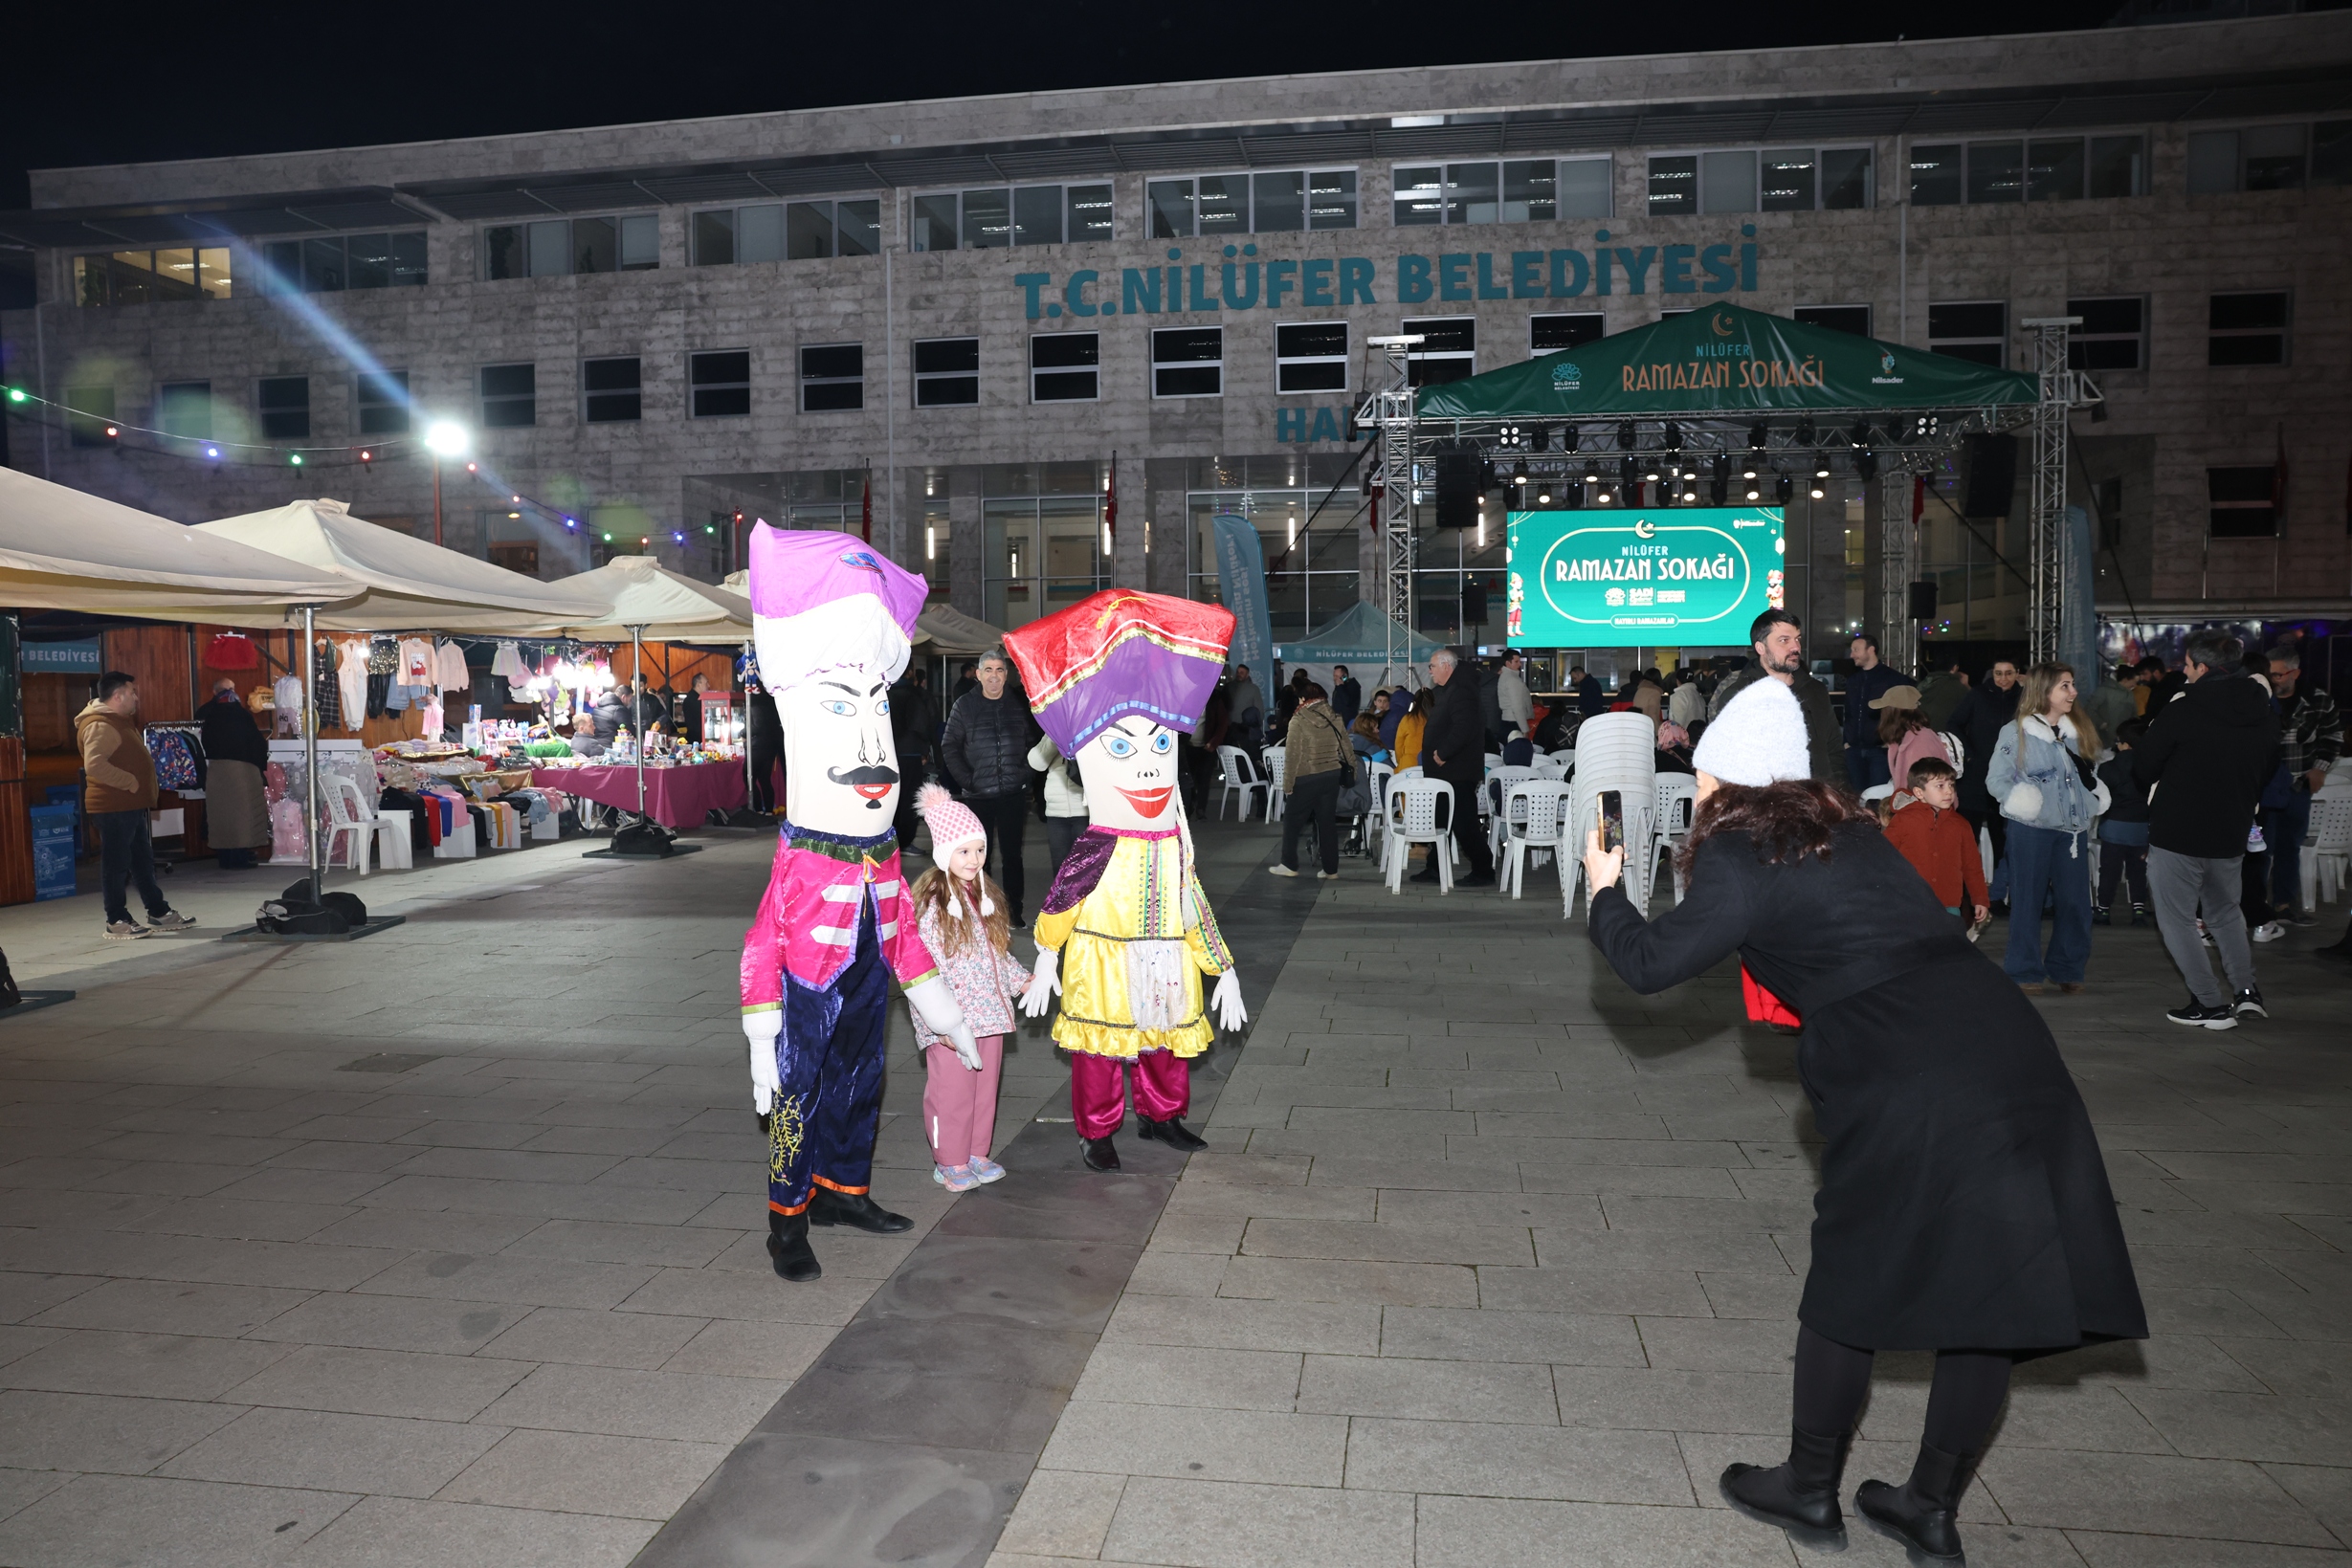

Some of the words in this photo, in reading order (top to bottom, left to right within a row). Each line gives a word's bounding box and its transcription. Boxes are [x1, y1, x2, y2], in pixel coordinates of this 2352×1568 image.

[1398, 223, 1759, 303] BELEDİYESİ
[1696, 342, 1751, 358] NİLÜFER
[1623, 361, 1730, 392] RAMAZAN
[1739, 354, 1824, 388] SOKAĞI
[1621, 544, 1669, 557] NİLÜFER
[1556, 558, 1652, 582] RAMAZAN
[1656, 553, 1734, 581] SOKAĞI
[29, 649, 100, 663] BELEDİYESİ
